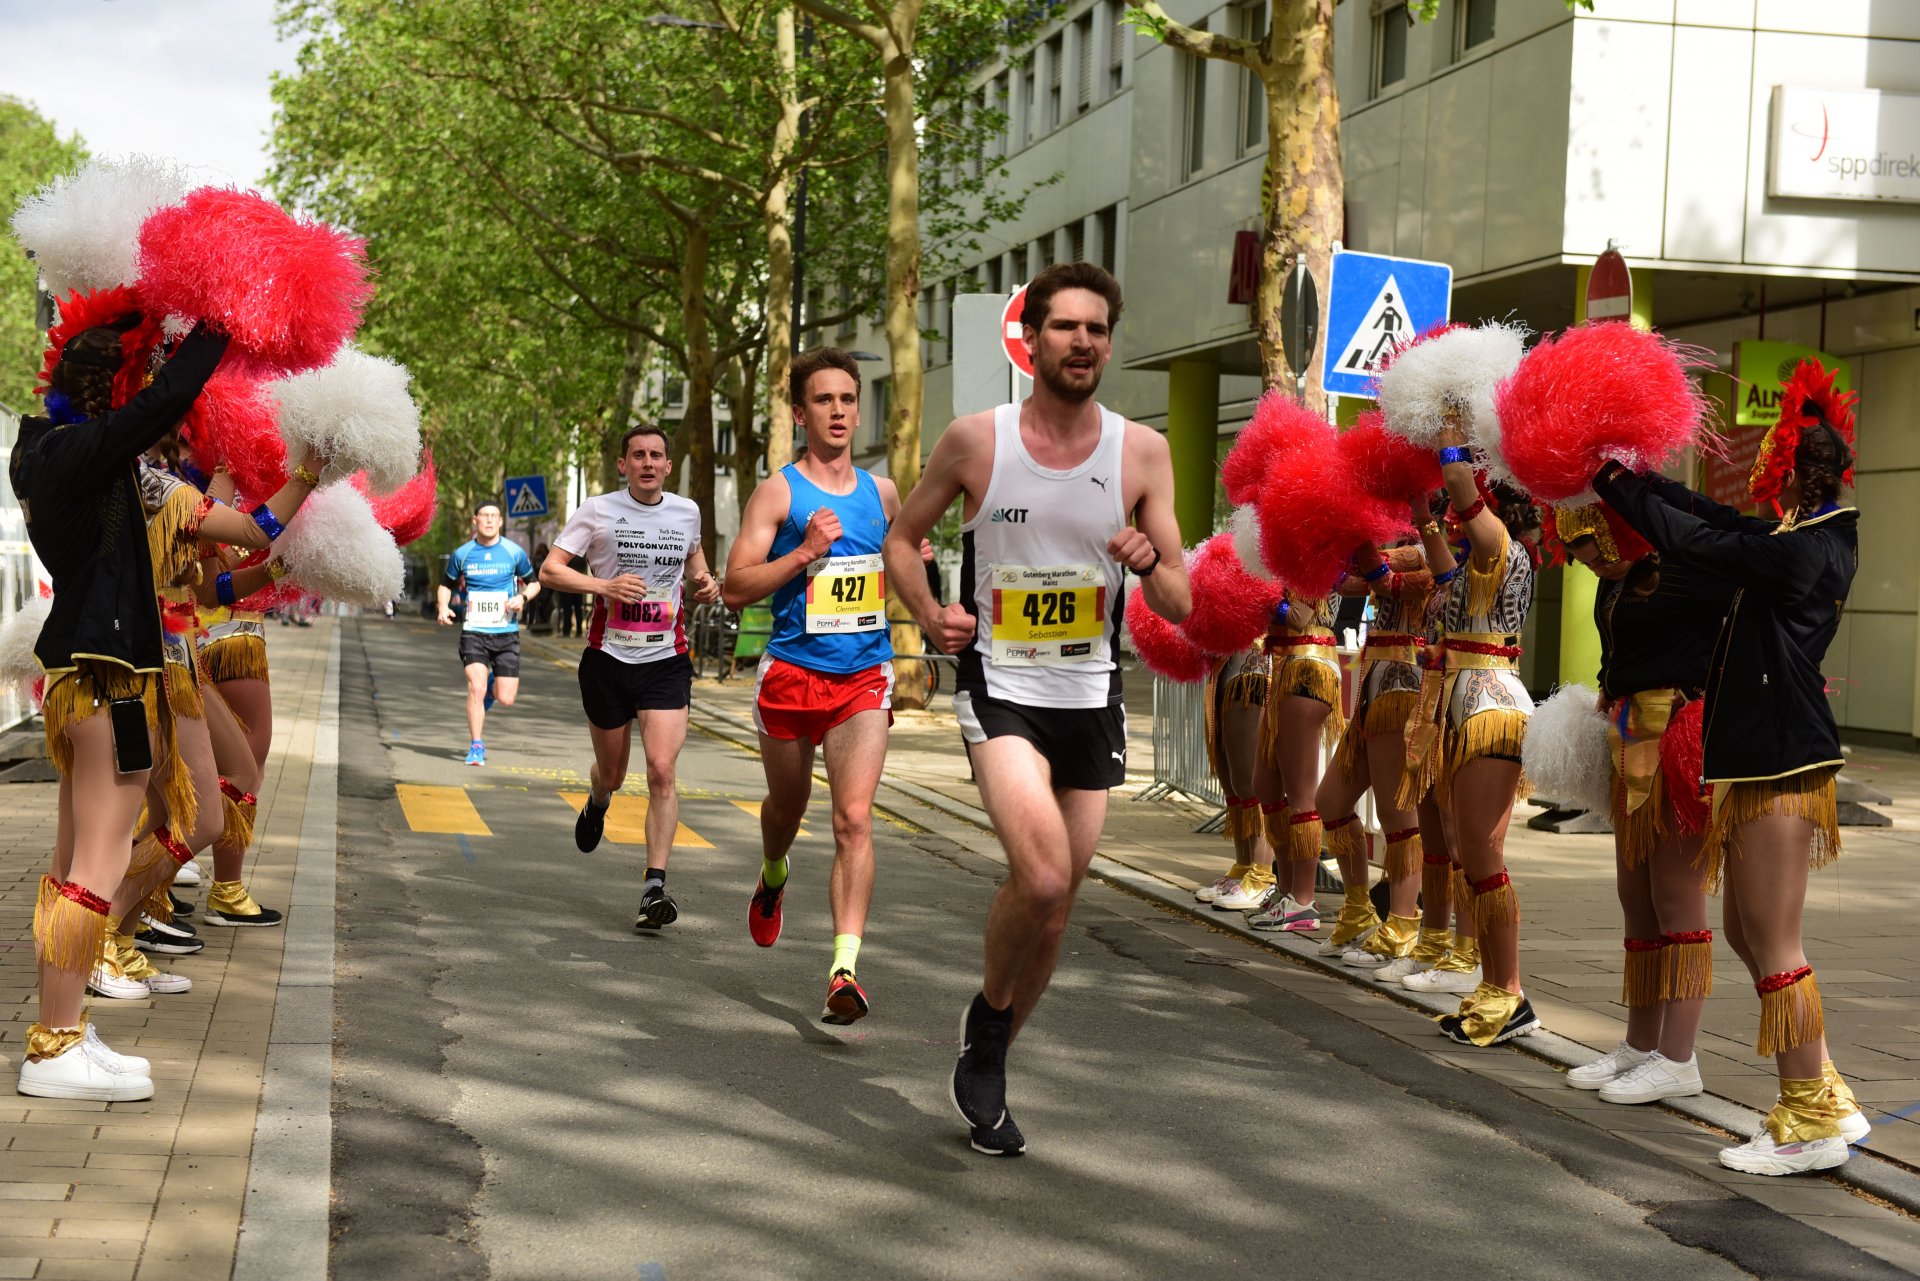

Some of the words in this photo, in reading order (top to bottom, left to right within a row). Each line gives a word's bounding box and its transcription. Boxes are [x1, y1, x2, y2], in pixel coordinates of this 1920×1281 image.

[1002, 508, 1028, 522] KIT
[1022, 570, 1050, 578] Gutenberg
[1052, 569, 1076, 578] Marathon
[830, 575, 866, 603] 427
[478, 601, 498, 612] 1664
[621, 602, 662, 623] 6082
[1022, 591, 1076, 626] 426
[1028, 629, 1068, 640] Sebastian
